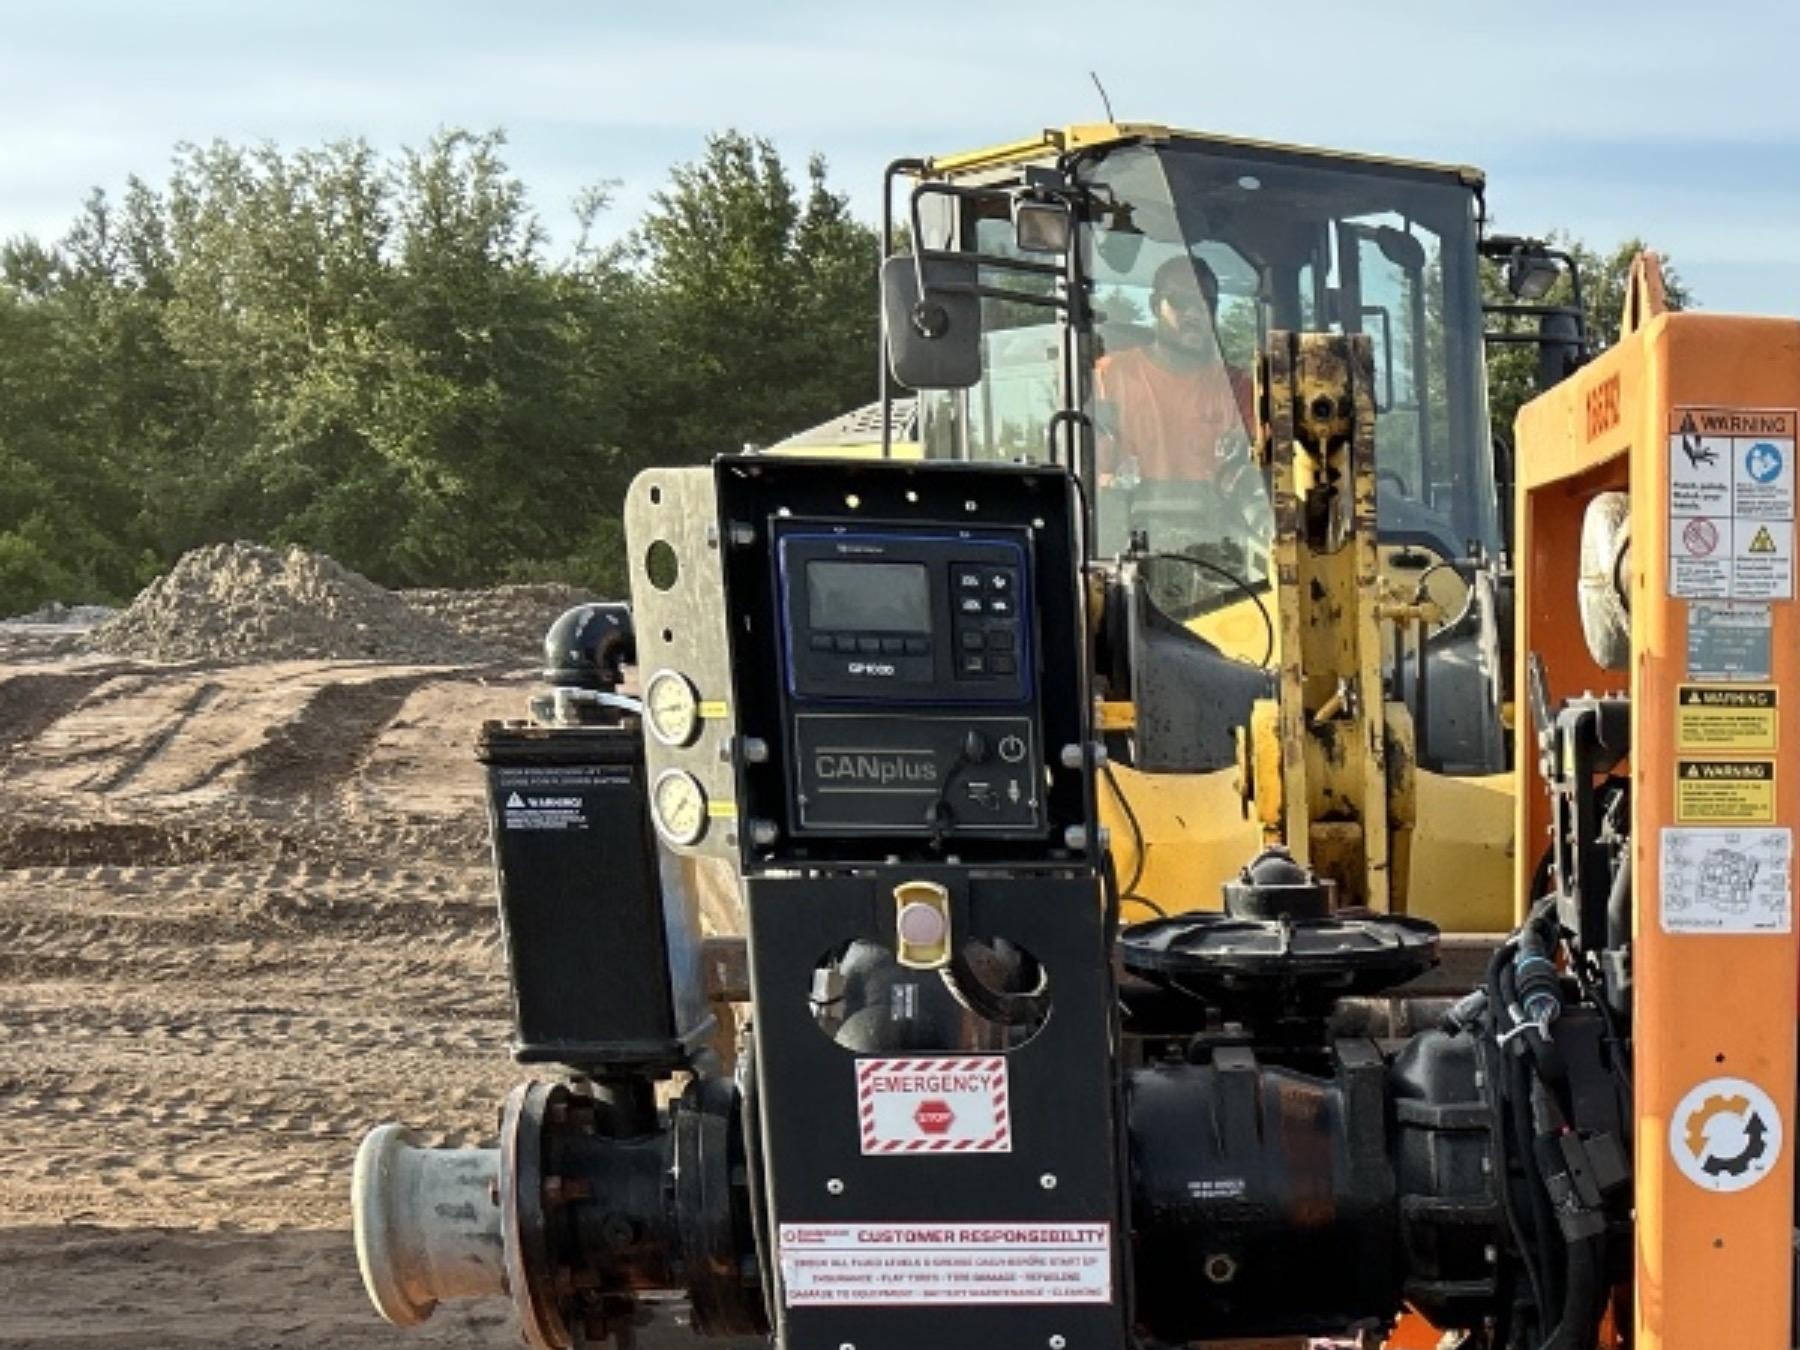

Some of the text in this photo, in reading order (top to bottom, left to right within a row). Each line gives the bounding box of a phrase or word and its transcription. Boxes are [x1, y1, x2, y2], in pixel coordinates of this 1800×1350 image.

[1700, 415, 1787, 433] WARNING
[1703, 691, 1769, 705] WARNING
[814, 756, 938, 785] CANplus
[1701, 764, 1766, 778] WARNING
[872, 1074, 991, 1093] EMERGENCY
[857, 1229, 954, 1243] CUSTOMER
[959, 1227, 1105, 1243] RESPONSIBILITY
